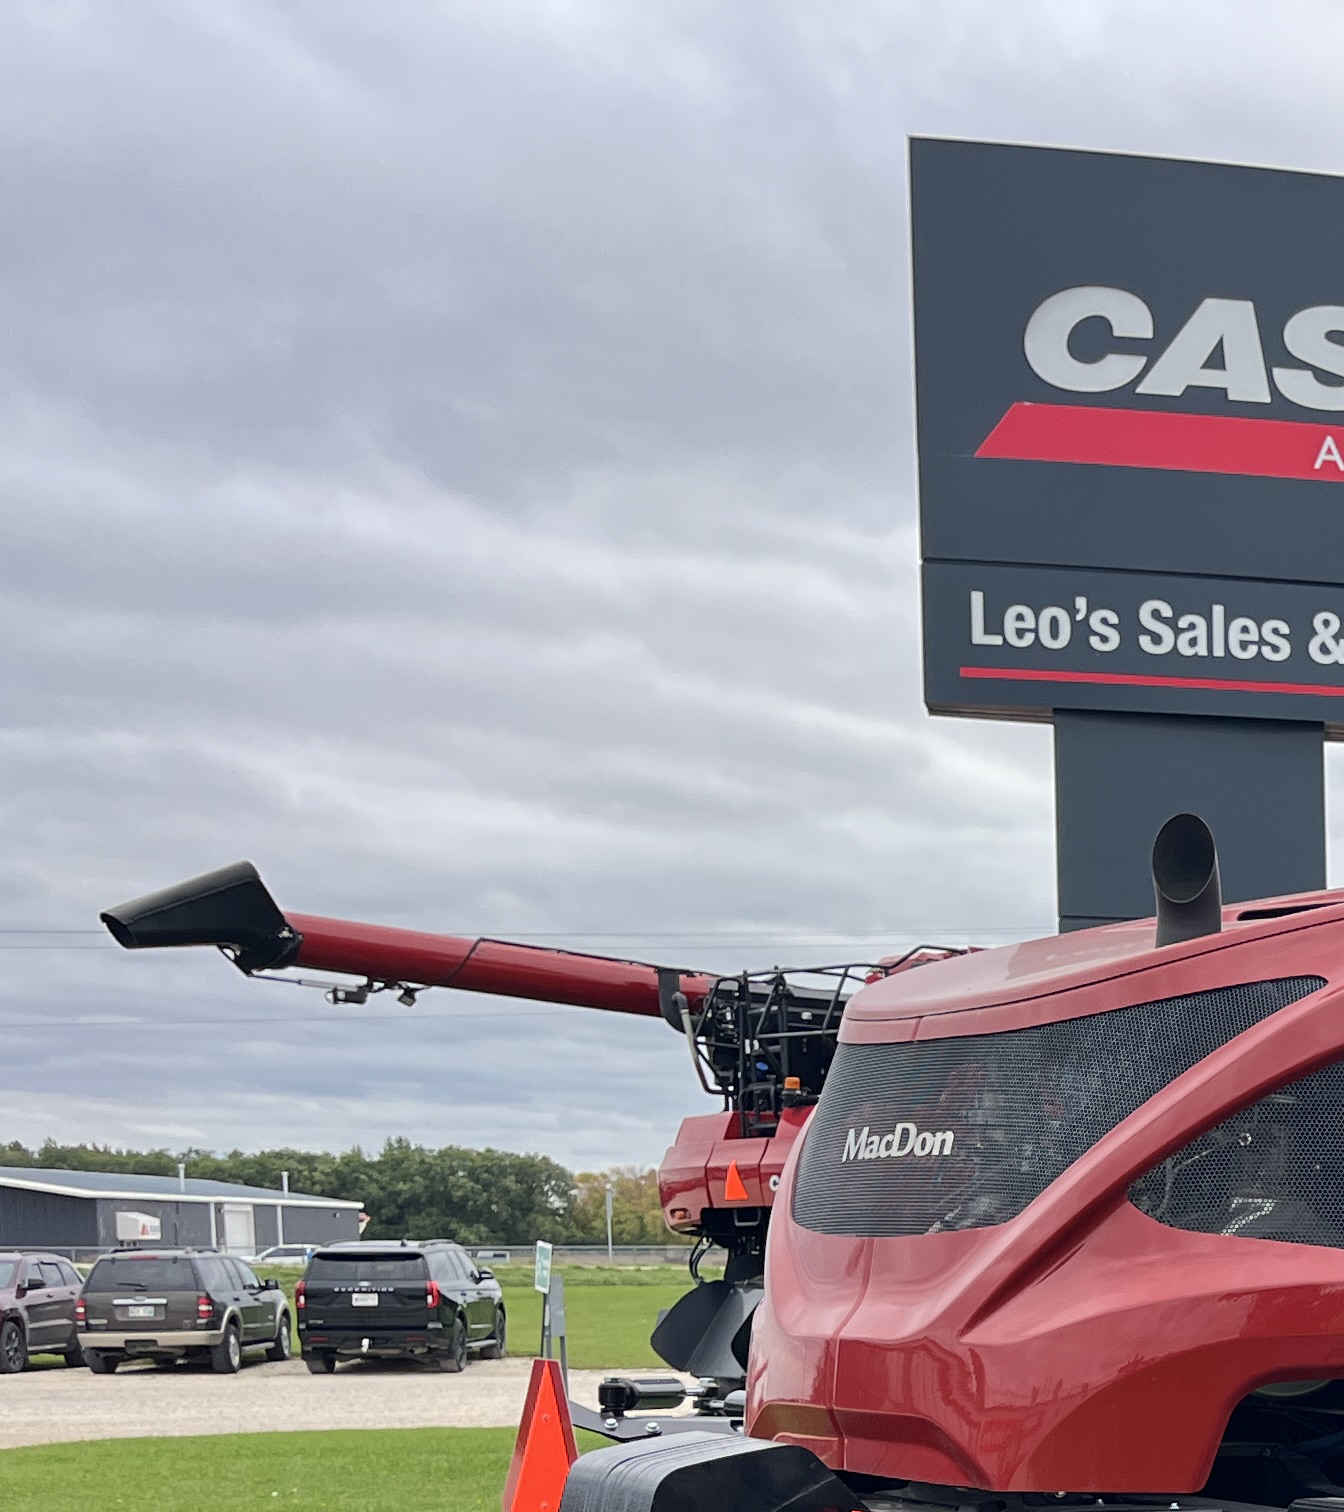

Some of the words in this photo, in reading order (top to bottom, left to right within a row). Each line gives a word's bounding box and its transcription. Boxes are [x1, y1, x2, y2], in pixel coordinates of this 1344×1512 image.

[969, 589, 1121, 653] Leo's
[1137, 598, 1293, 663] Sales
[841, 1122, 955, 1163] MacDon
